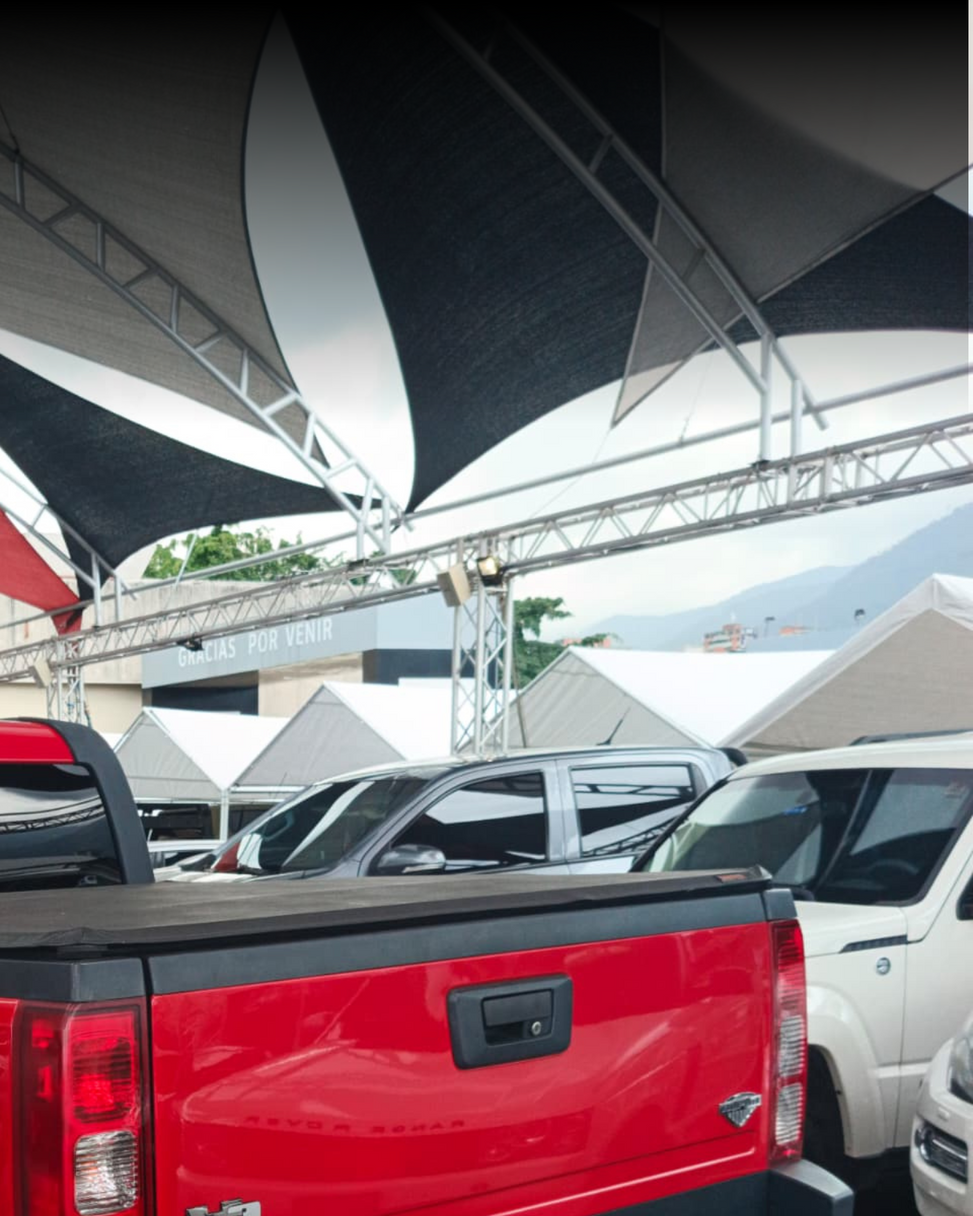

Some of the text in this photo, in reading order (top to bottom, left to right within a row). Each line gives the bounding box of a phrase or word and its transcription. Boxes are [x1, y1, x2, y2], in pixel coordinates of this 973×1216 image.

[179, 618, 333, 667] GRACIAS POR VENIR
